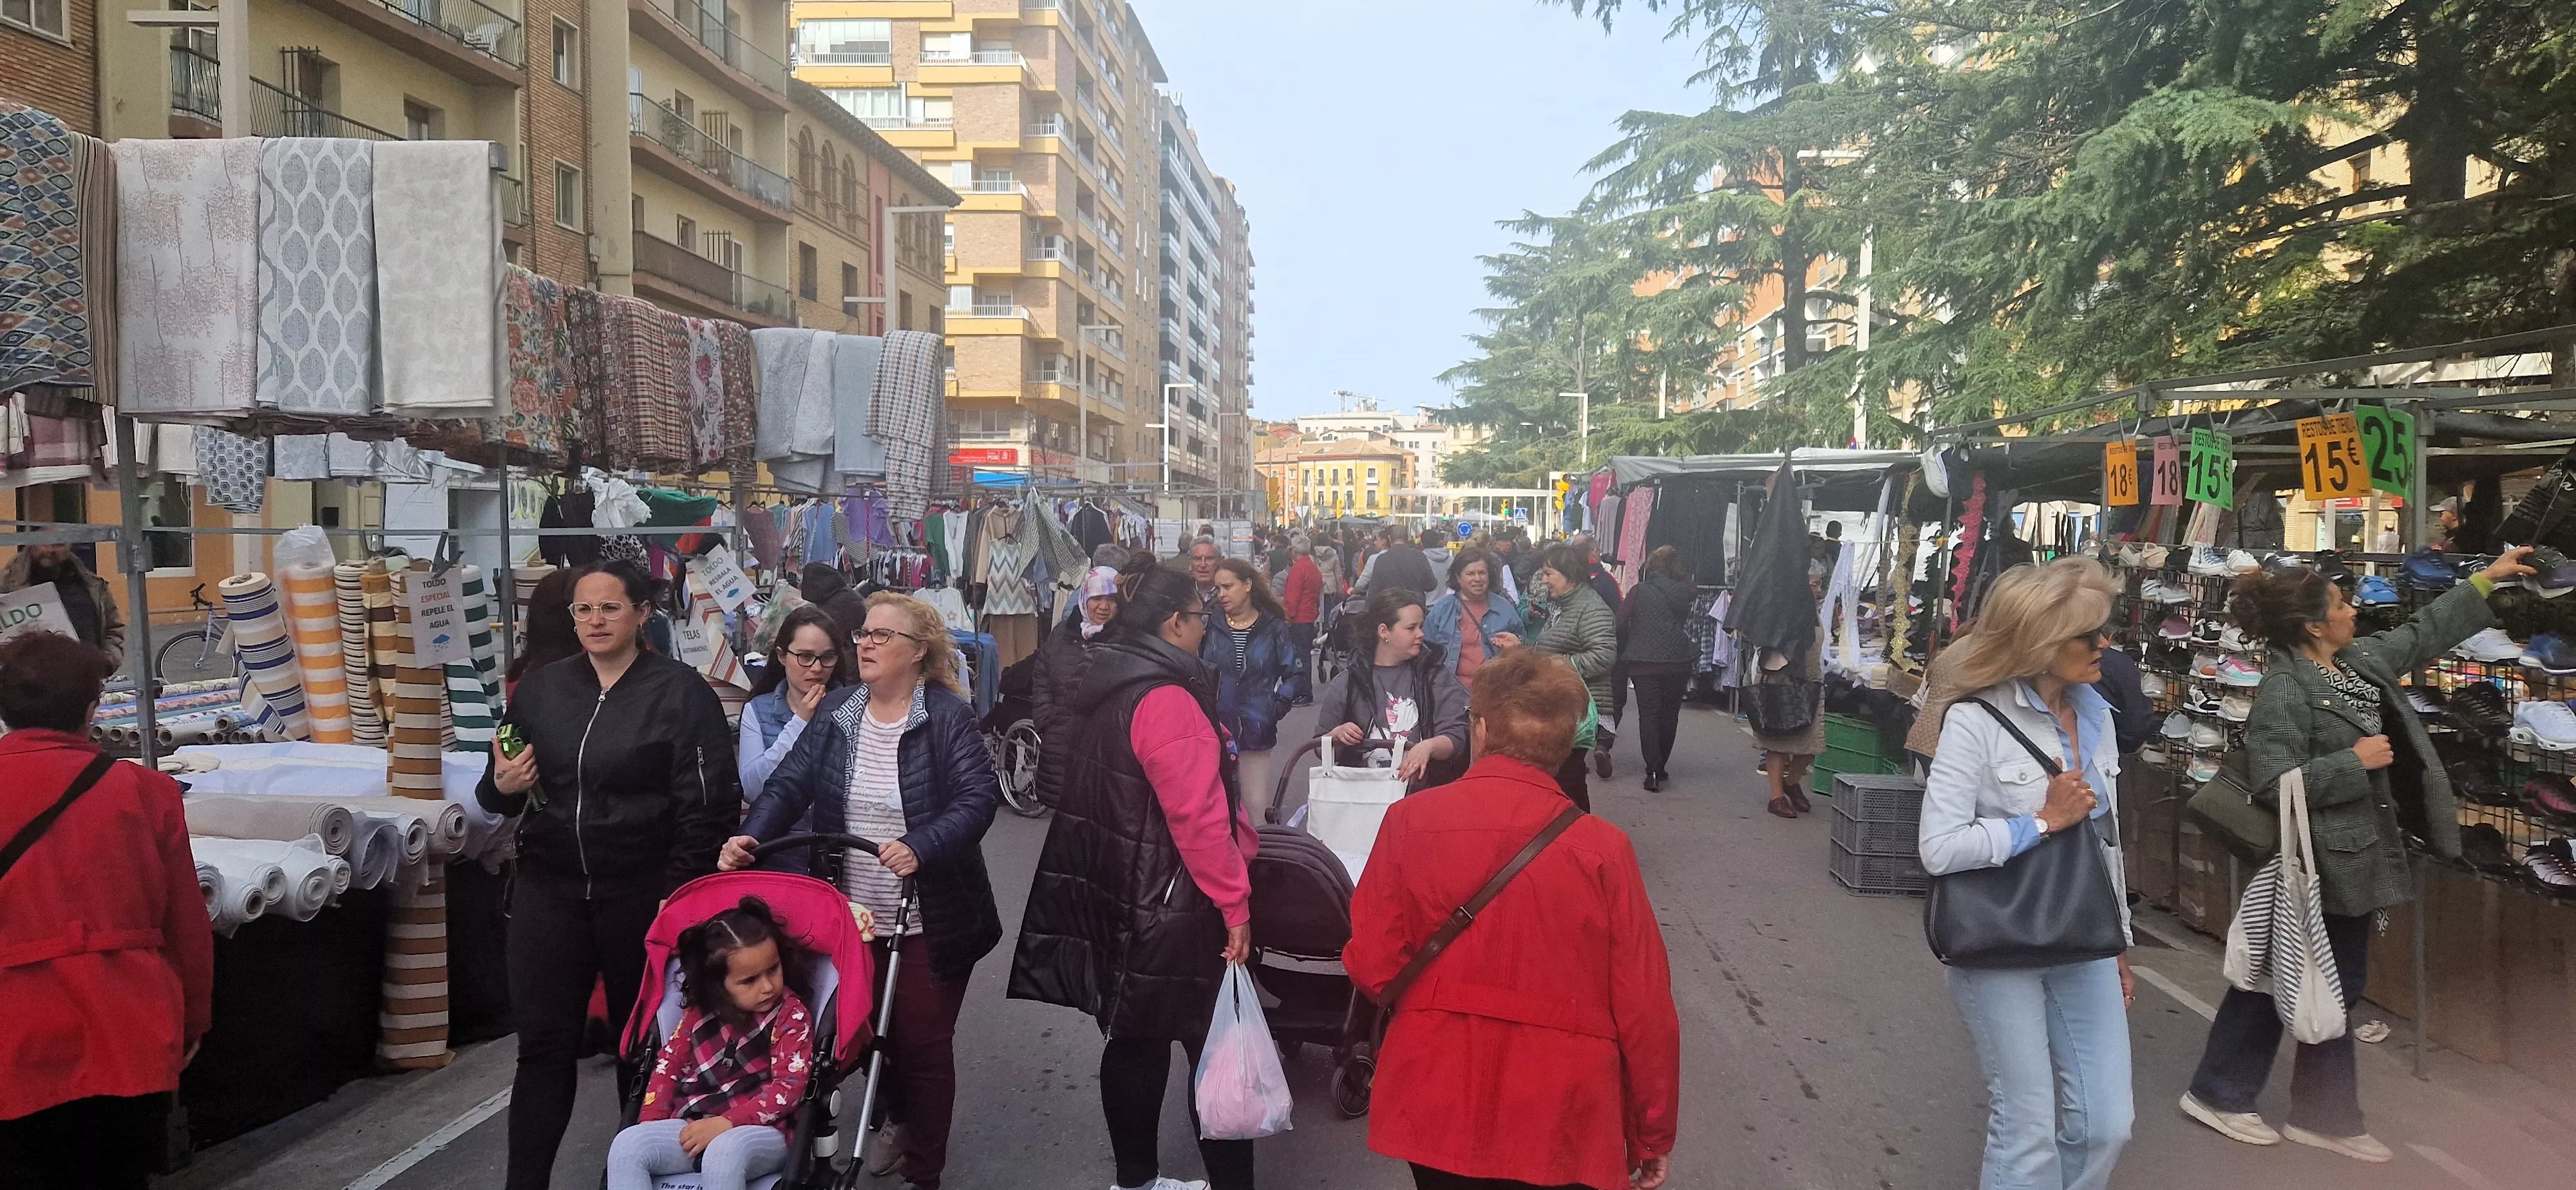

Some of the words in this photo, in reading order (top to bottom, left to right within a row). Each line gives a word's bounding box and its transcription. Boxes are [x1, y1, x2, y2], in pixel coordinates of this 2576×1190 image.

[2305, 437, 2360, 493] 15€
[2110, 464, 2132, 497] 18€
[2192, 451, 2230, 499] 15€
[701, 557, 723, 576] TOLDO
[422, 578, 446, 589] TOLDO
[708, 567, 732, 587] RESBALA
[723, 576, 739, 590] AGUA
[421, 591, 451, 603] ESPECIAL
[0, 603, 43, 628] LDO
[421, 605, 446, 617] REPELE
[430, 619, 450, 629] AGUA
[682, 629, 701, 640] TELAS
